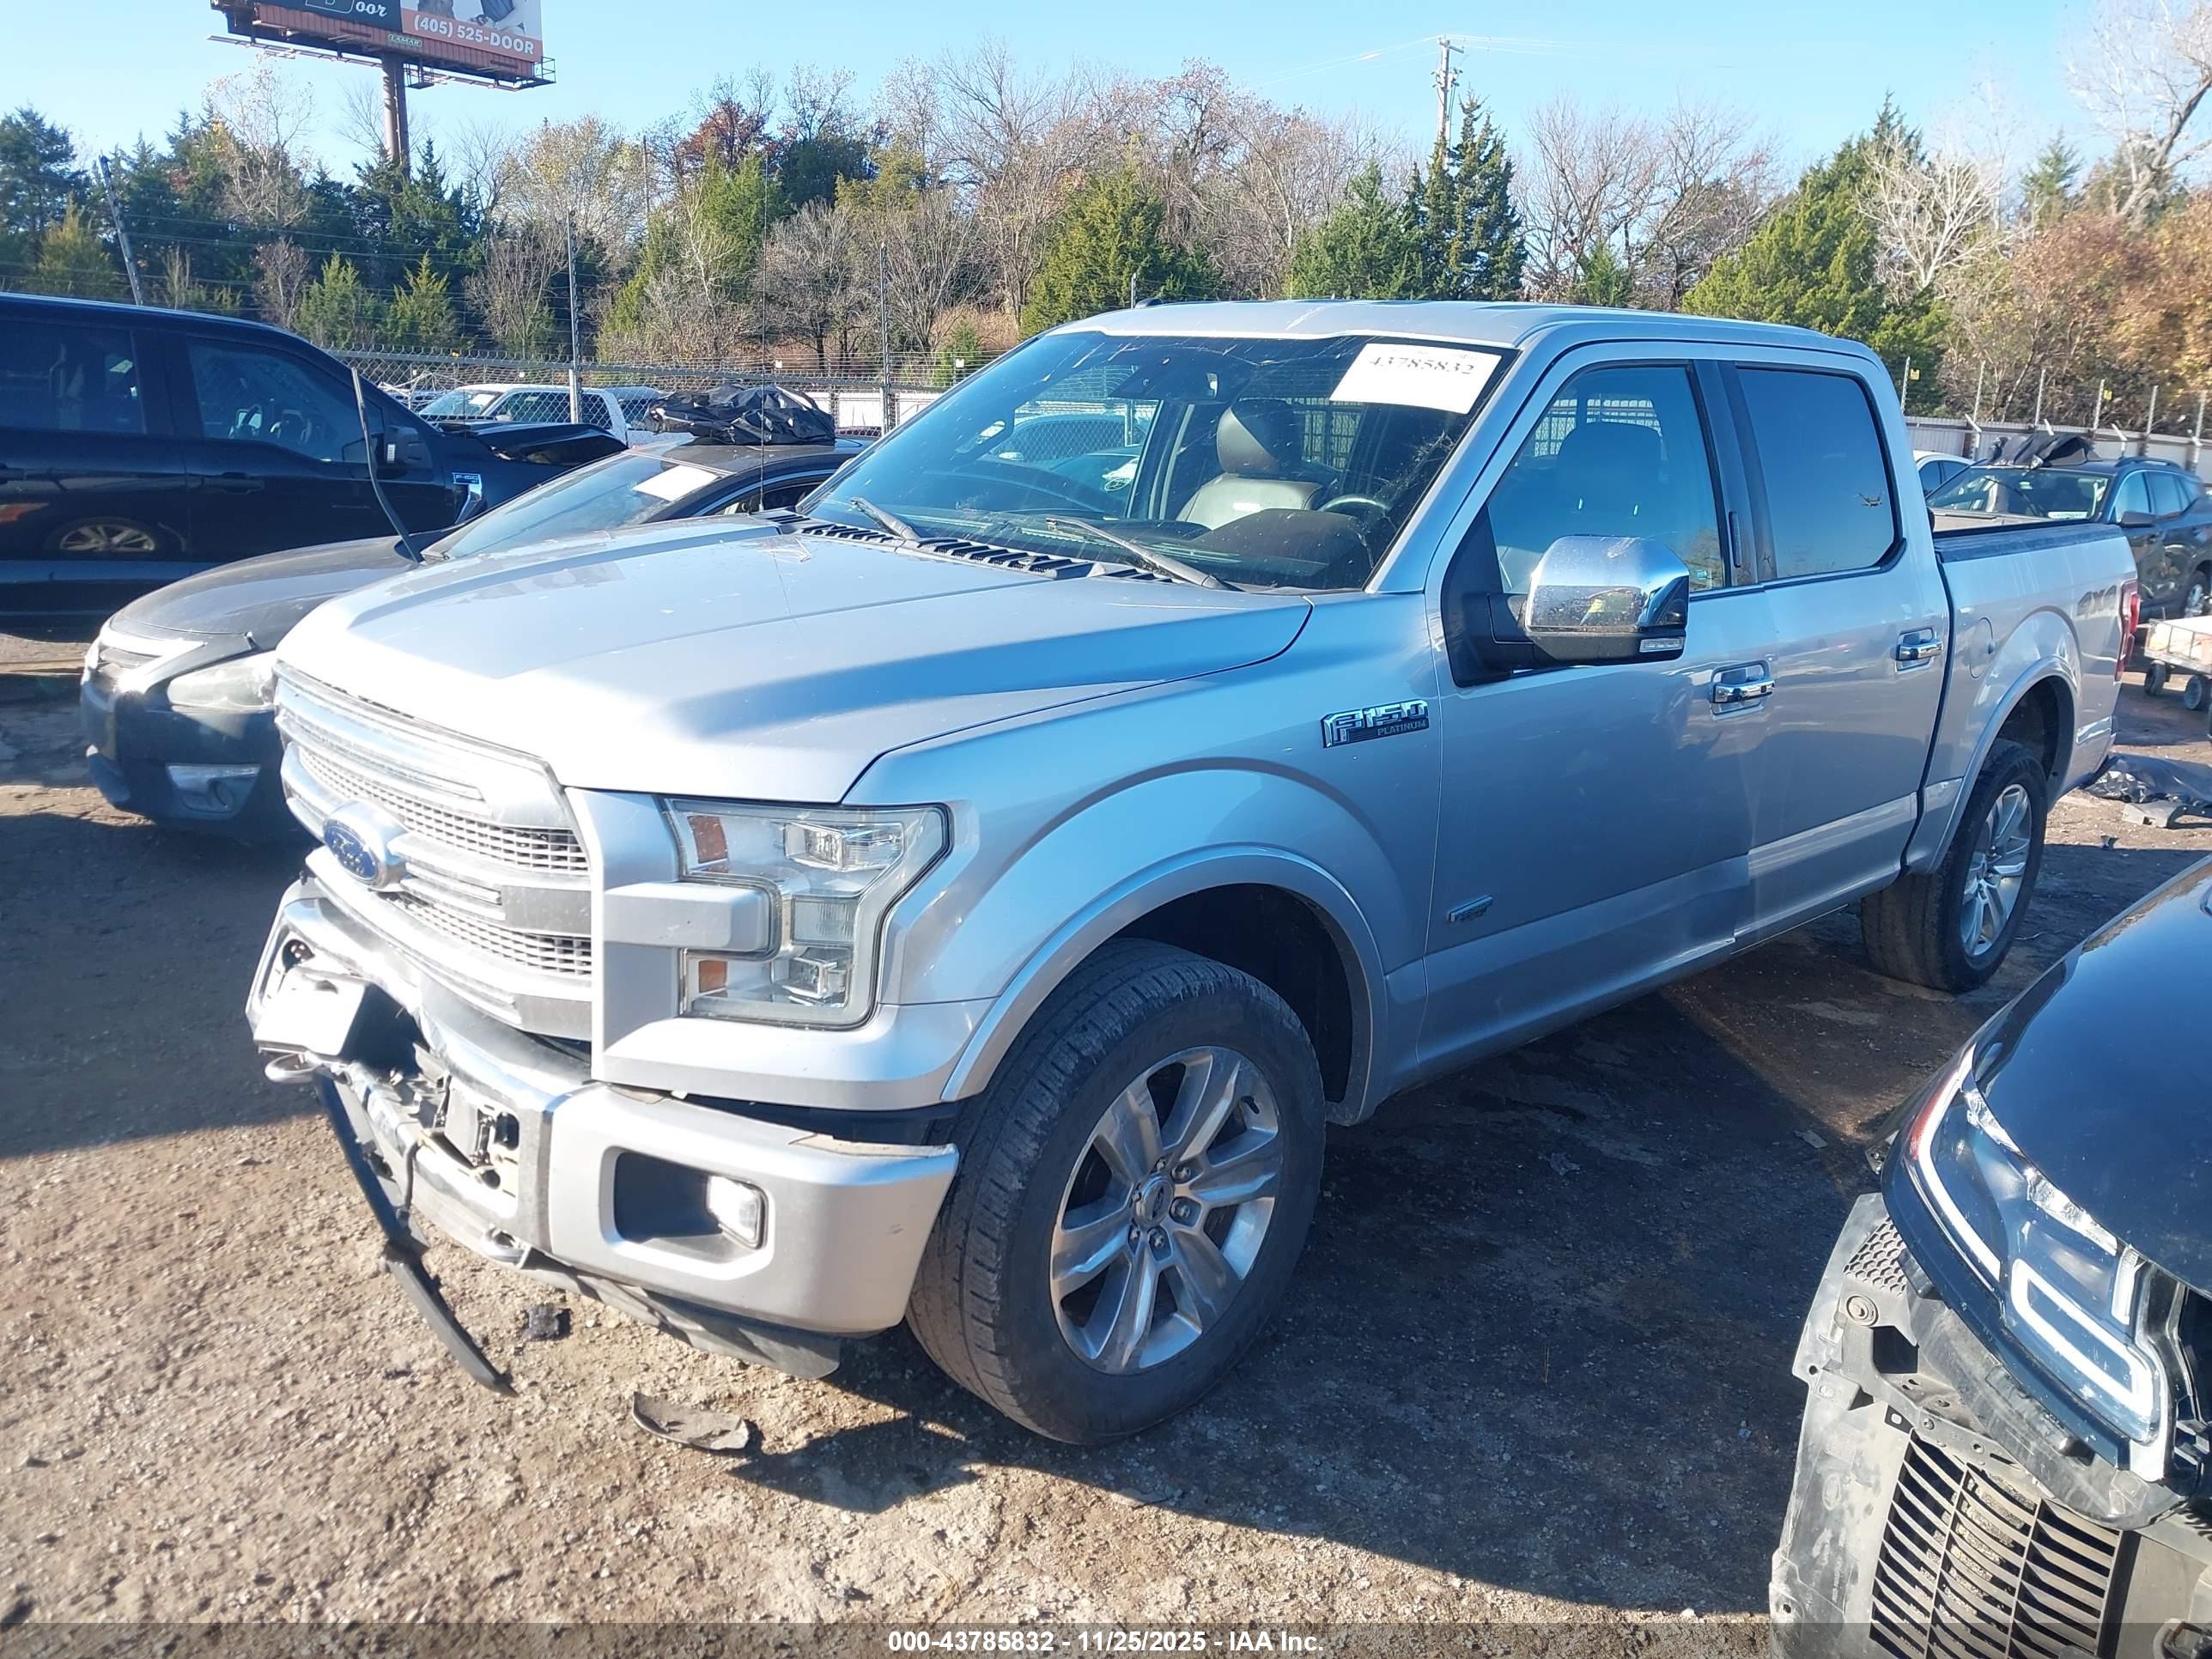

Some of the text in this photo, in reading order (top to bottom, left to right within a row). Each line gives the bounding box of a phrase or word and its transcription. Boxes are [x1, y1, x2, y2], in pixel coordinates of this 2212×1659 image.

[414, 14, 534, 55] (405) 525-DOOR
[1369, 353, 1474, 374] 43785832
[1376, 720, 1427, 736] PLATINUM
